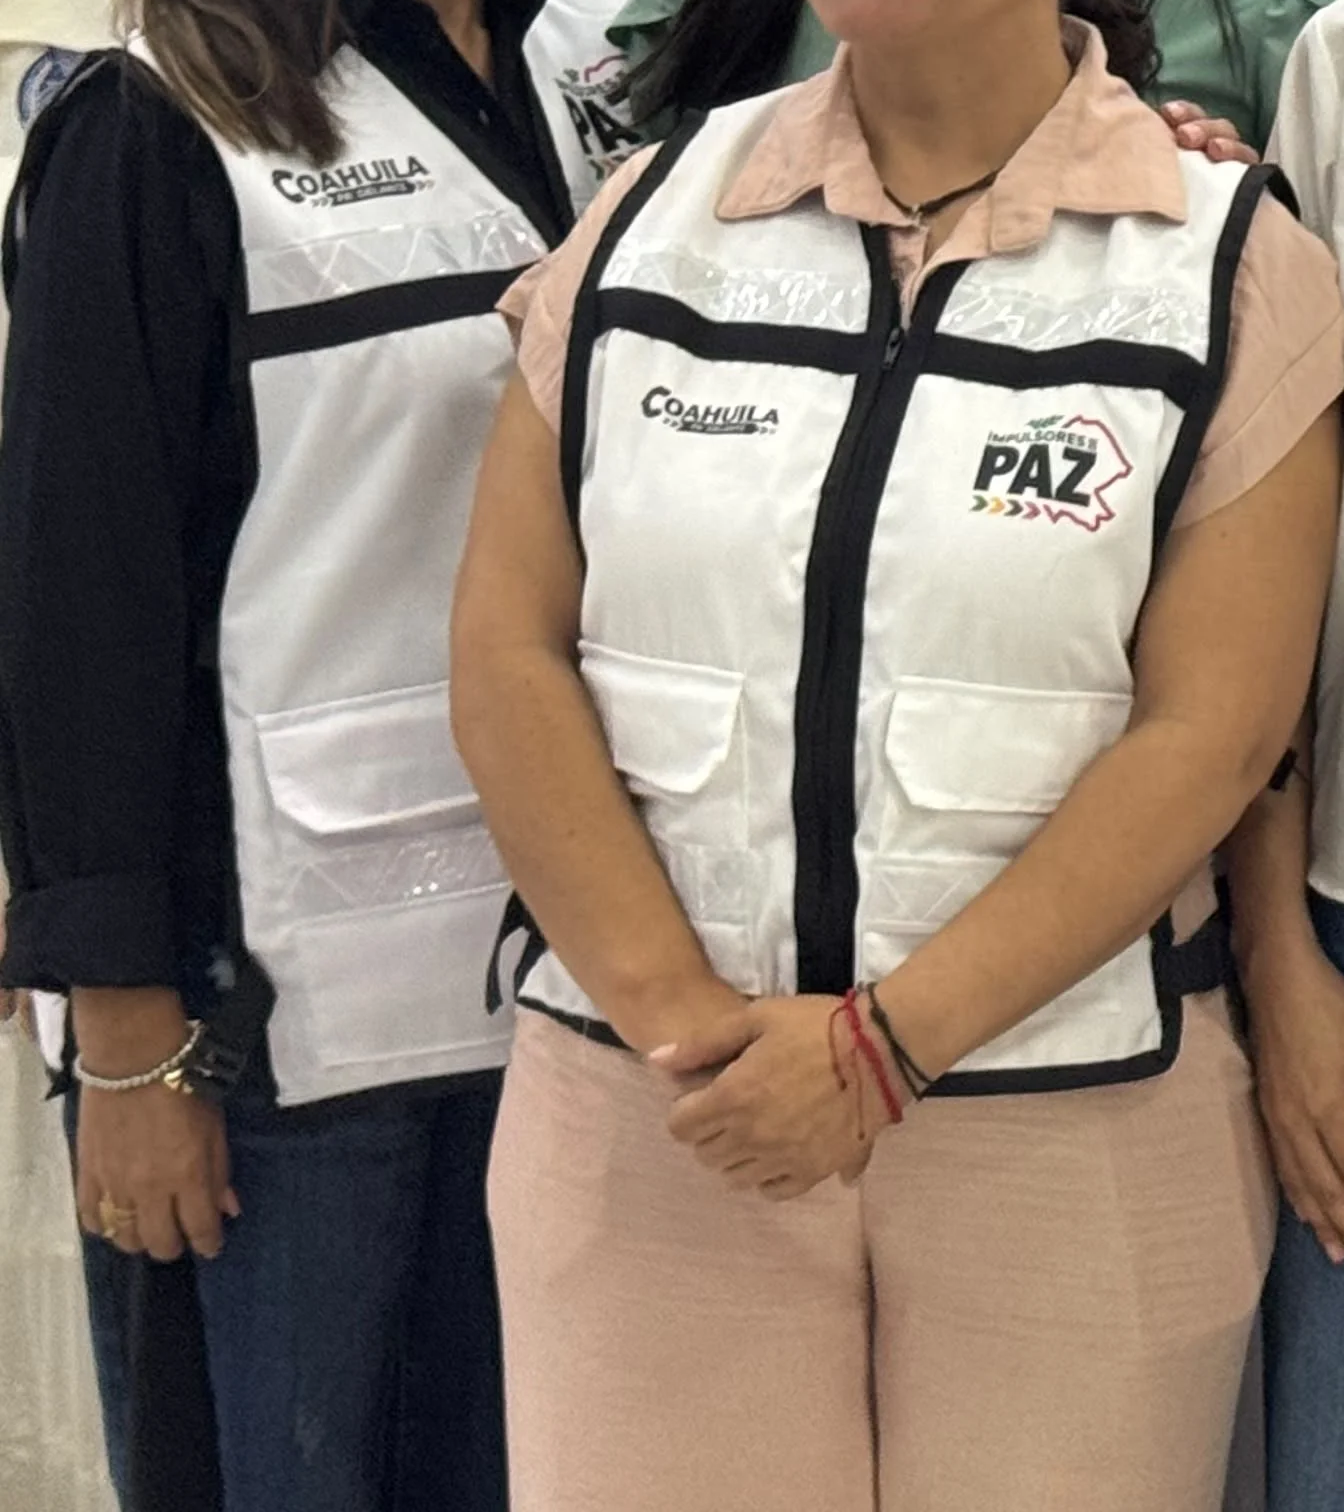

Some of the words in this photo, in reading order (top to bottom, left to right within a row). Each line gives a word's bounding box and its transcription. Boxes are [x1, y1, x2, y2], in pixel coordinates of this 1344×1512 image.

[272, 156, 430, 203] COAHUILA
[641, 386, 779, 426] COAHUILA
[987, 430, 1086, 448] IMPULSORES
[973, 443, 1097, 507] PAZ
